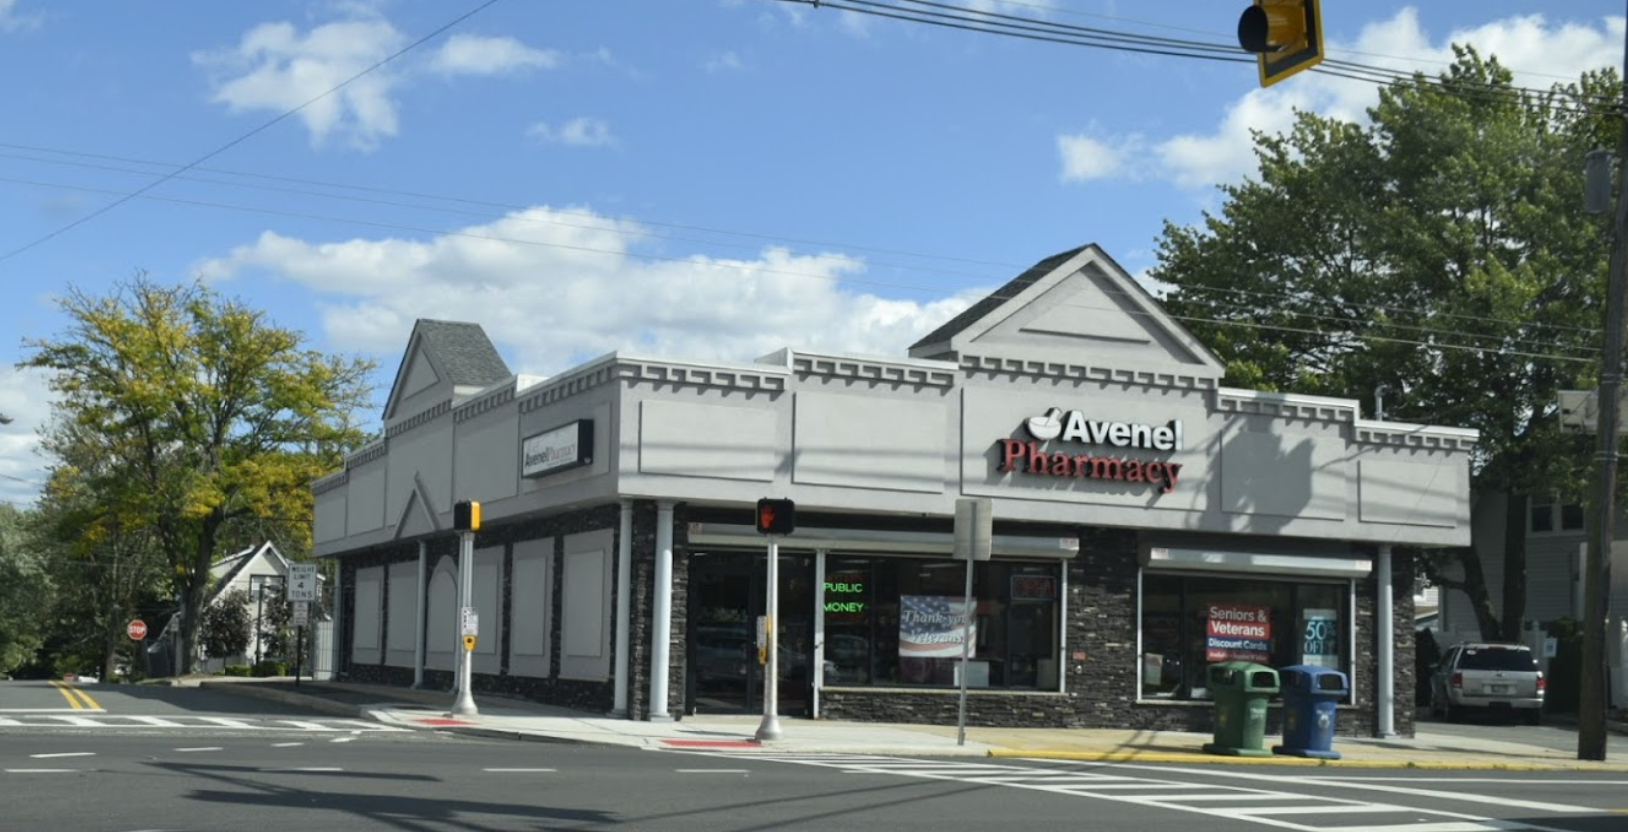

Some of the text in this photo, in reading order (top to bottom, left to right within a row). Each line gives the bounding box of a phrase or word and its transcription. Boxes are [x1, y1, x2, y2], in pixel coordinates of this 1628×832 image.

[1062, 410, 1183, 450] Avenel
[1001, 439, 1184, 494] Pharmacy
[297, 581, 304, 589] 4
[823, 582, 864, 593] PUBLIC
[291, 590, 313, 598] TONS
[823, 602, 865, 612] MONEY
[1209, 606, 1267, 622] Seniors &
[128, 625, 146, 634] STOP
[1211, 620, 1266, 637] Veterans
[1208, 638, 1268, 651] Discount Cards
